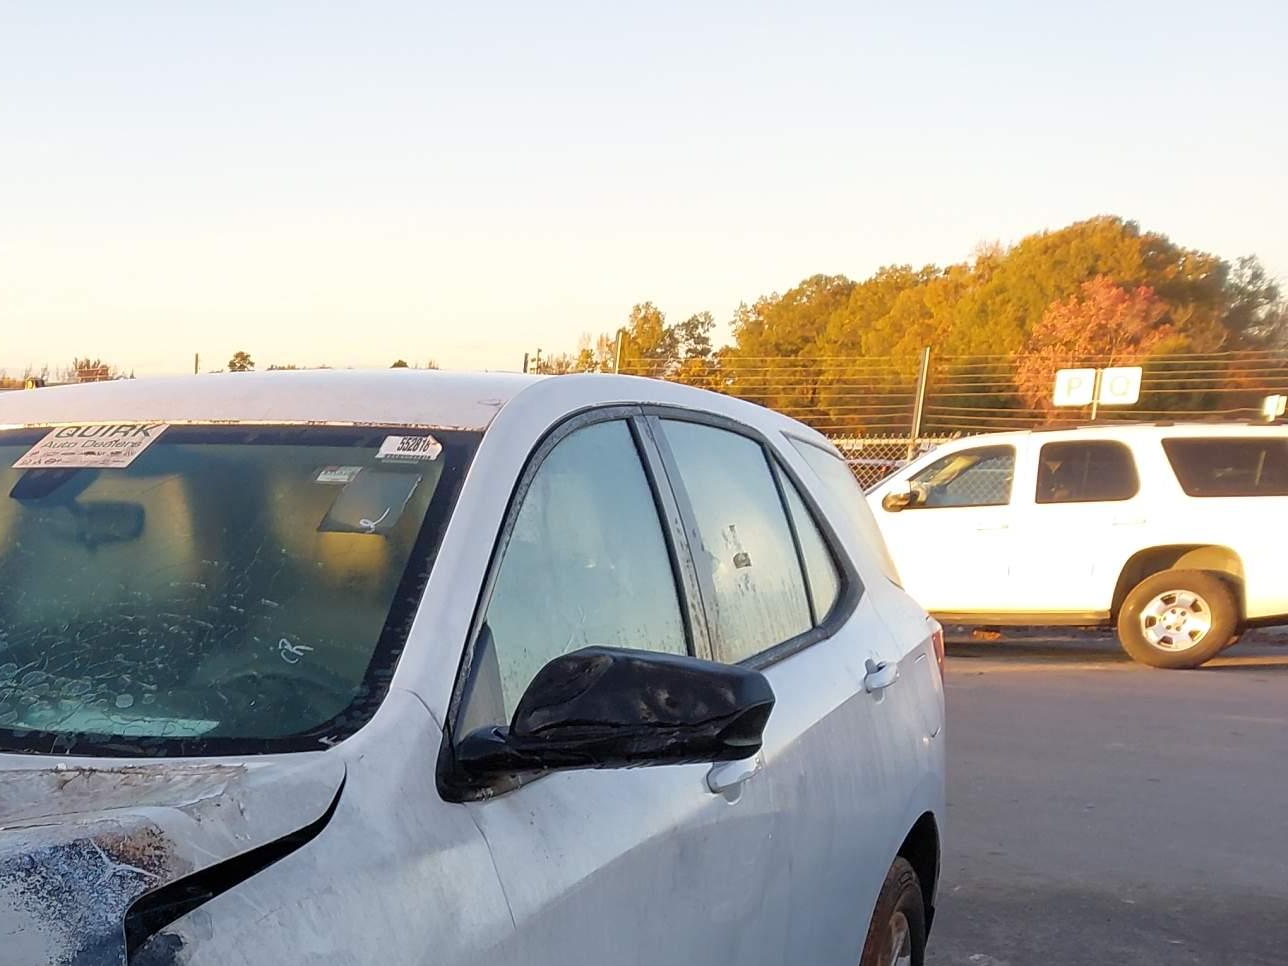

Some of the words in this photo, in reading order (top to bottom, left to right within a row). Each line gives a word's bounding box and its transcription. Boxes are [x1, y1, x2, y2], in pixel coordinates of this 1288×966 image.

[1067, 377, 1082, 397] P
[54, 424, 162, 438] QUIRK
[41, 440, 77, 449] Auto
[80, 439, 142, 448] Dealers
